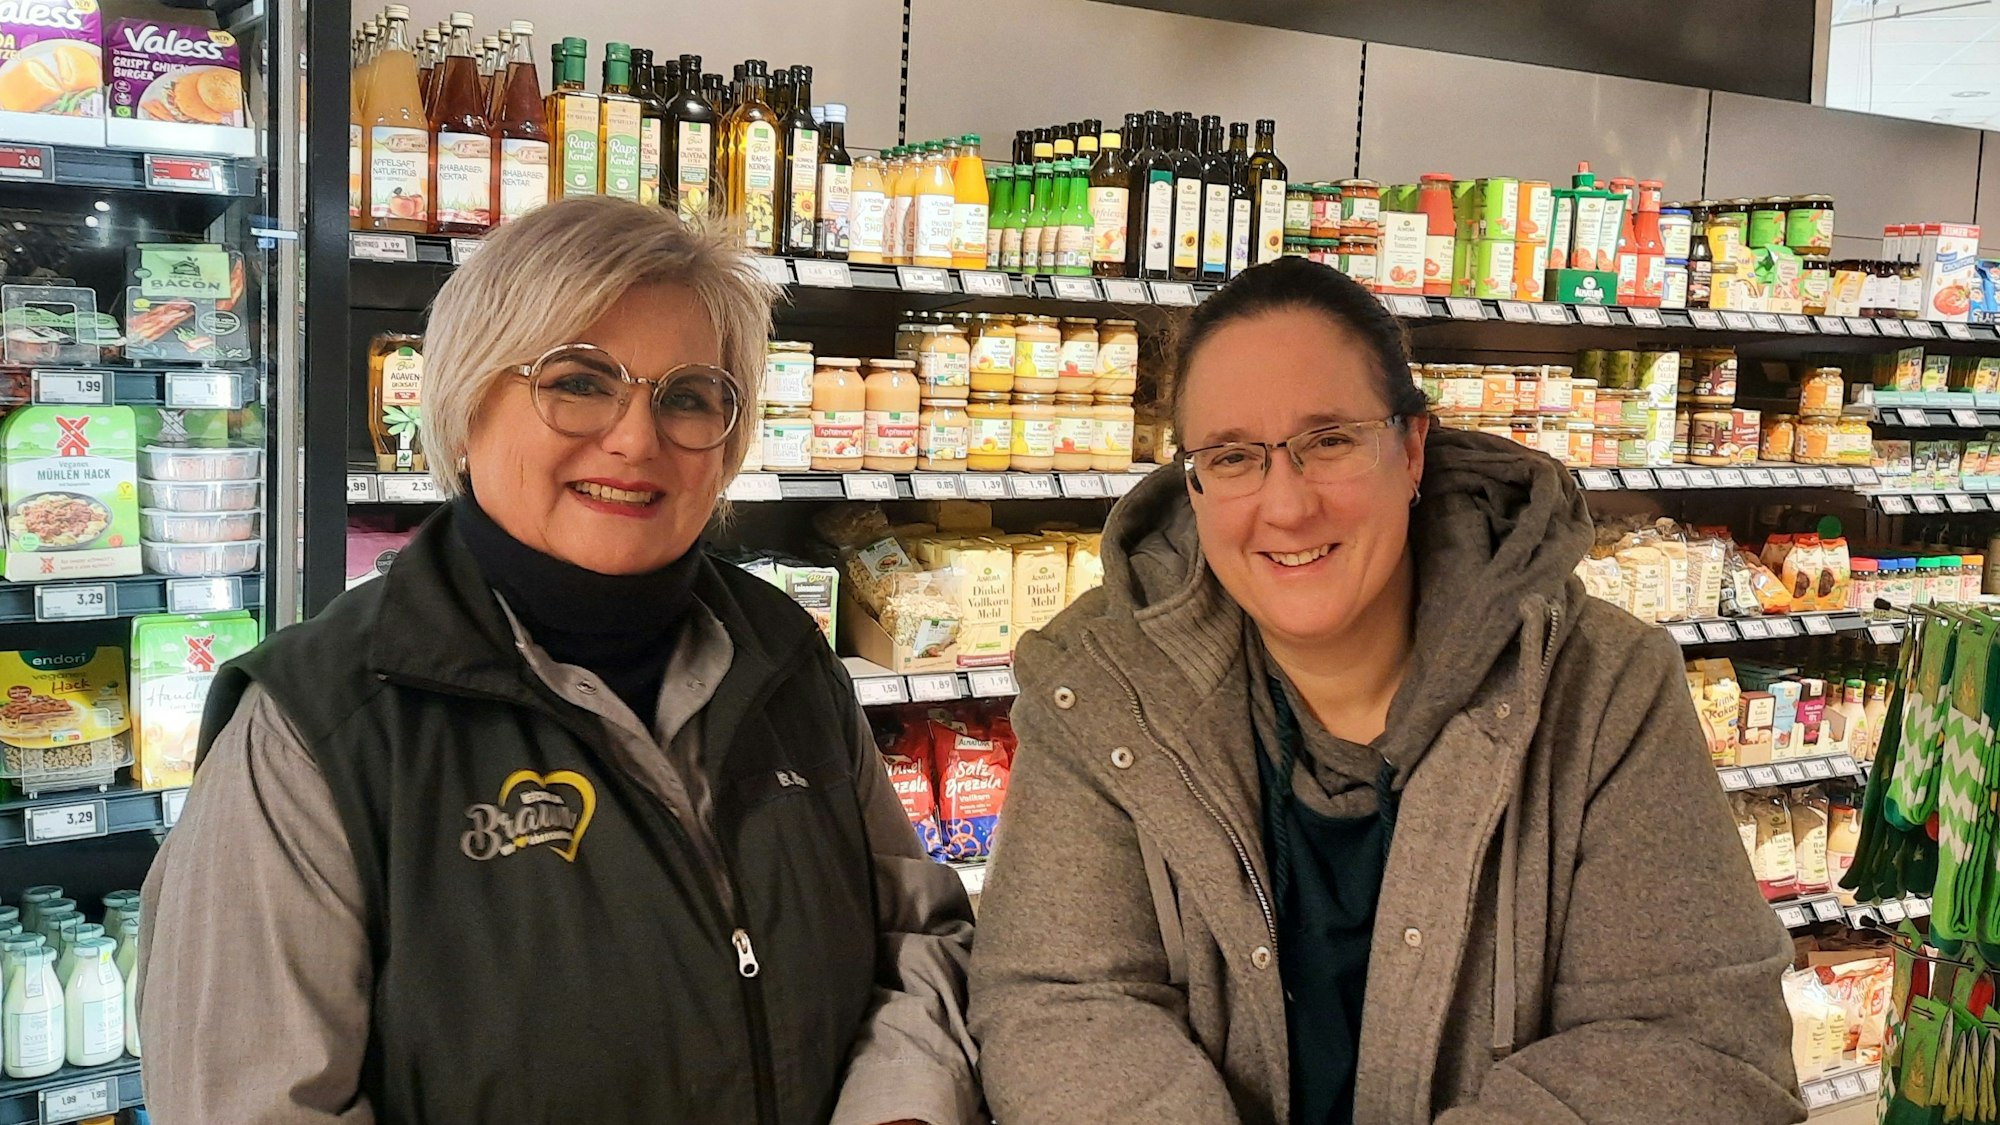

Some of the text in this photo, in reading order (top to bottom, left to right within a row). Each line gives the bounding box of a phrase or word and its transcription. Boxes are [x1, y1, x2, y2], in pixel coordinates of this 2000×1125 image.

[0, 0, 82, 30] aless
[123, 25, 224, 60] Valess
[113, 56, 151, 71] CRISPY
[113, 67, 155, 81] BURGER
[567, 134, 596, 152] Raps
[609, 138, 638, 158] Raps
[19, 155, 41, 168] 2,49
[568, 151, 594, 162] Kernöl
[610, 155, 636, 166] Kernöl
[680, 151, 707, 160] OLIVENÖL
[150, 279, 221, 291] BACON
[982, 278, 1001, 287] 1,19
[390, 373, 423, 381] AGAVEN-
[77, 380, 101, 393] 1,99
[37, 467, 111, 481] MÜHLEN HACK
[347, 482, 367, 491] ,99
[412, 482, 434, 491] 2,39
[871, 480, 888, 490] 1,49
[982, 480, 1001, 490] 1,39
[1029, 480, 1048, 490] 1,99
[1080, 480, 1099, 490] 0,99
[972, 584, 1006, 597] Dinkel
[1027, 583, 1060, 596] Dinkel
[77, 593, 103, 606] 3,29
[968, 596, 1009, 608] Vollkorn
[1031, 595, 1056, 608] Mehl
[977, 606, 1001, 619] Mehl
[32, 653, 86, 667] endori
[52, 677, 91, 695] Hack
[881, 683, 898, 693] 1,59
[930, 680, 950, 690] 1,89
[990, 676, 1009, 687] 1,99
[1713, 693, 1735, 709] Trink
[956, 758, 989, 777] Salz
[944, 777, 1001, 799] Brezeln
[66, 810, 93, 825] 3,29
